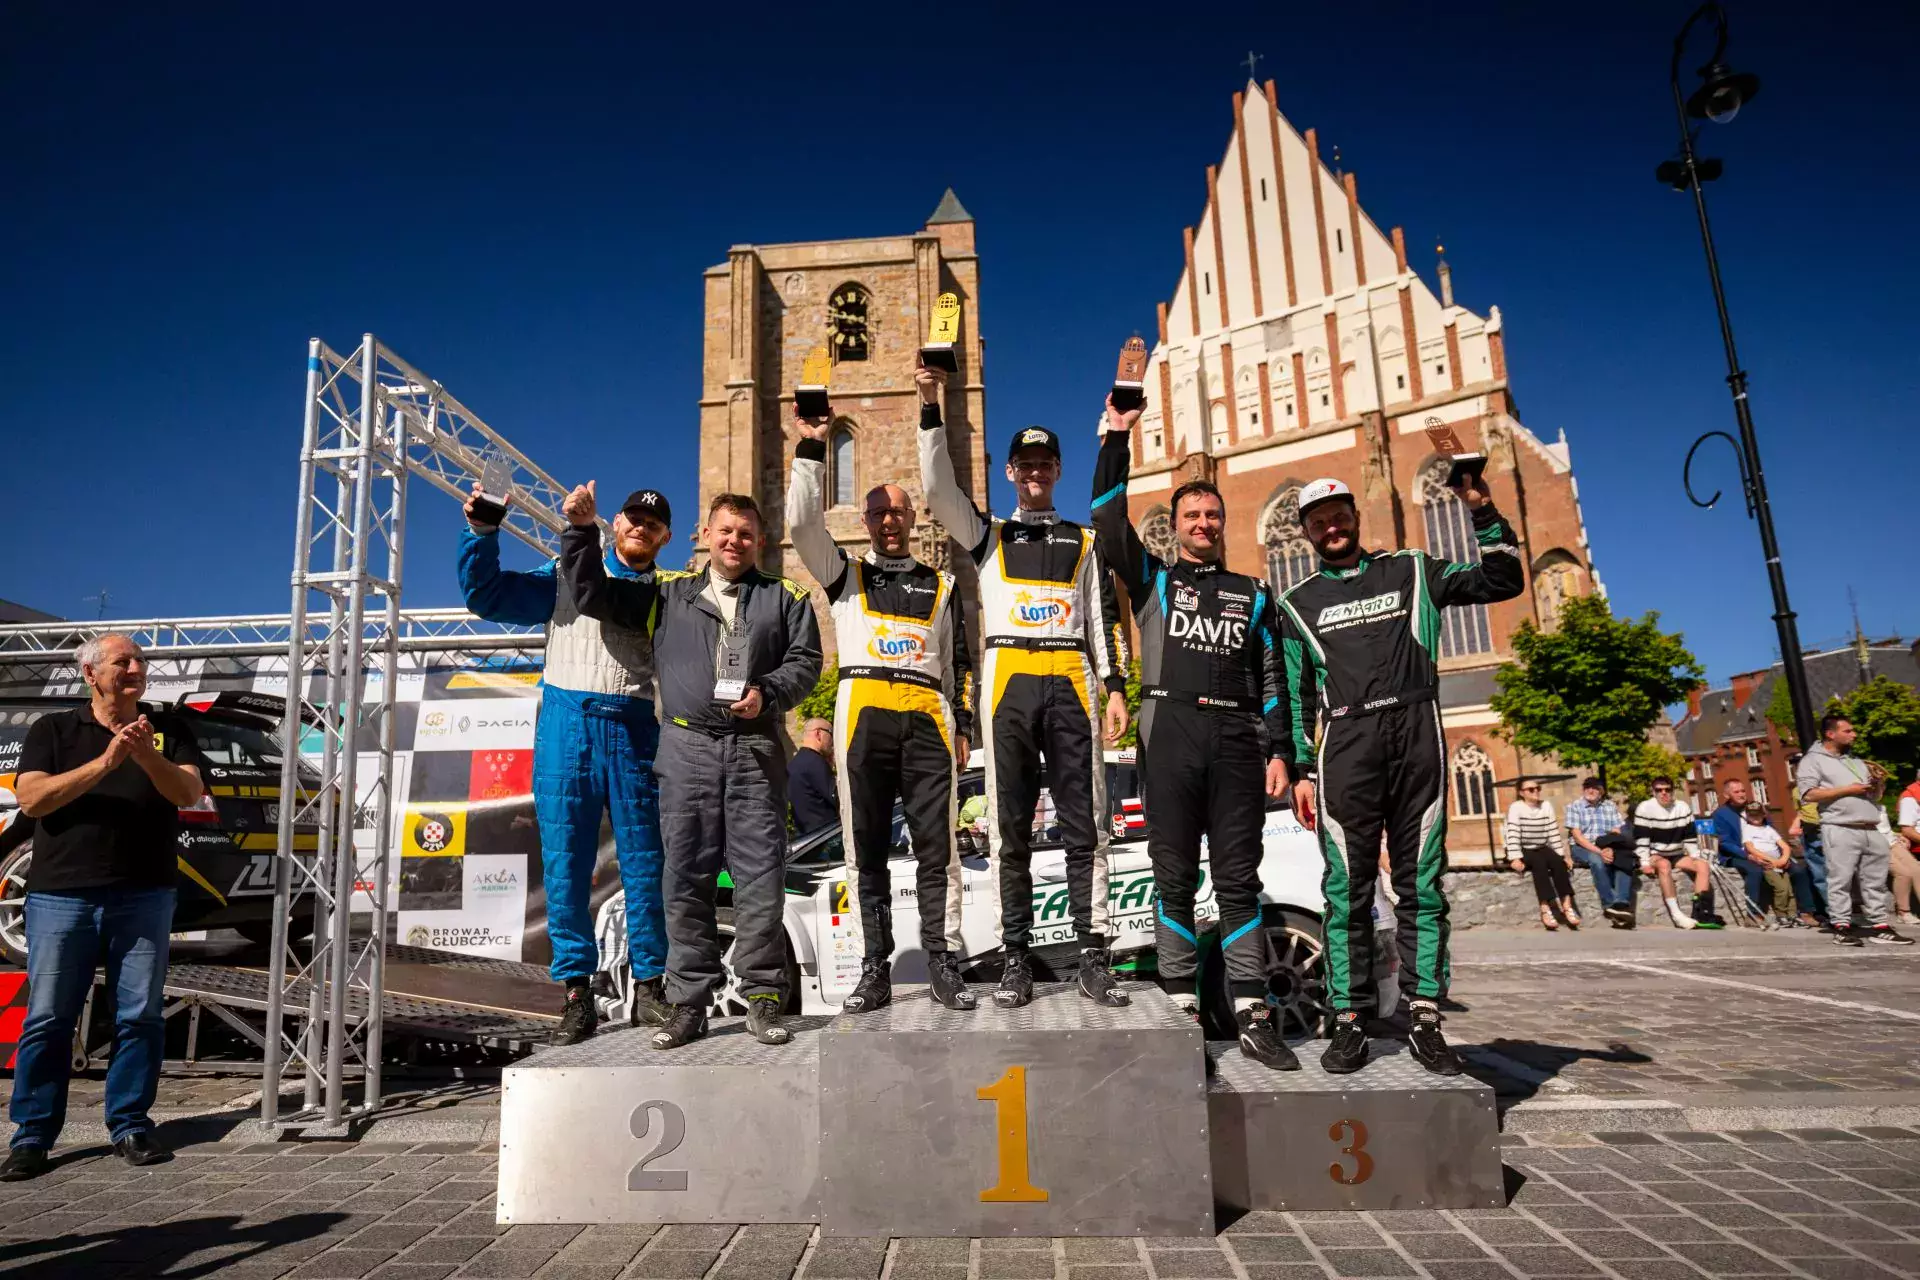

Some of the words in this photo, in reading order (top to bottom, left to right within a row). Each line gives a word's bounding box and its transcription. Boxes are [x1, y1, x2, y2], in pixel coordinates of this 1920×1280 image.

[1020, 603, 1059, 621] LOTTO
[1321, 595, 1397, 622] FANFARO
[1168, 610, 1246, 649] DAVIS
[1319, 625, 1335, 634] HIGH
[1335, 618, 1365, 629] QUALITY
[1365, 614, 1392, 624] MOTOR
[878, 638, 917, 655] LOTTO
[1182, 641, 1231, 655] FABRICS
[1150, 689, 1169, 697] HRX
[1364, 696, 1399, 710] M.FERUGA
[477, 719, 531, 728] DACIA
[422, 841, 445, 852] PZM
[432, 927, 490, 936] BROWAR
[432, 935, 512, 947] GŁUBCZYCE
[977, 1065, 1049, 1203] 1
[627, 1099, 688, 1192] 2
[1328, 1118, 1374, 1185] 3
